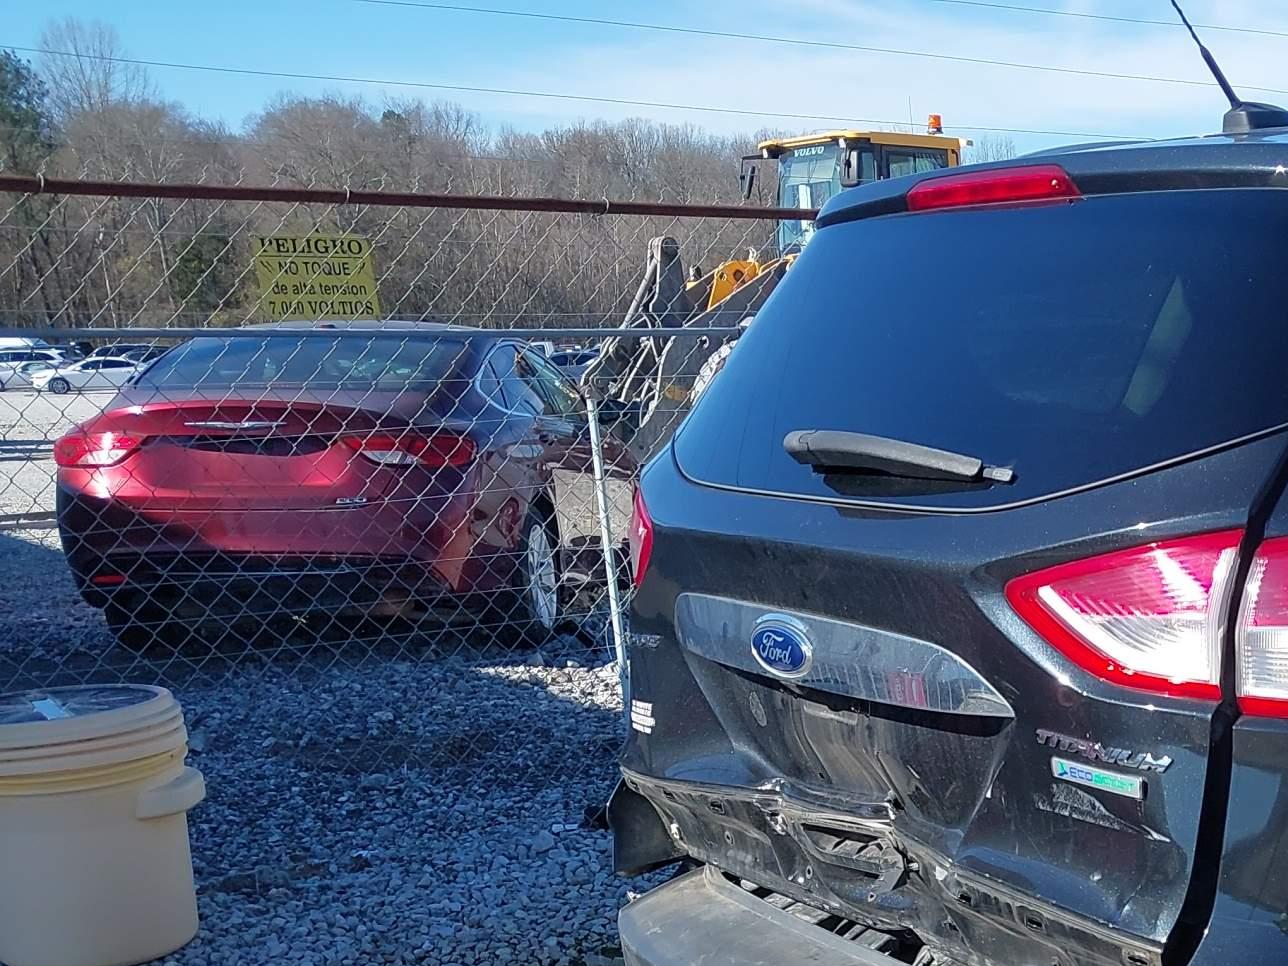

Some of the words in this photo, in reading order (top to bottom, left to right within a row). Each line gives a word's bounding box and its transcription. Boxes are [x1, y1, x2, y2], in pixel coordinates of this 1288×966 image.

[794, 146, 825, 158] VOLVO
[259, 238, 363, 255] PELIGRO
[278, 262, 299, 276] NO
[302, 261, 351, 276] TOQUE
[271, 281, 289, 295] de
[292, 281, 316, 296] alta
[319, 281, 367, 296] tension
[269, 300, 305, 316] 7,000
[307, 300, 374, 316] VOLTIOS
[760, 631, 792, 664] Ford
[1035, 728, 1174, 773] TITANIUM
